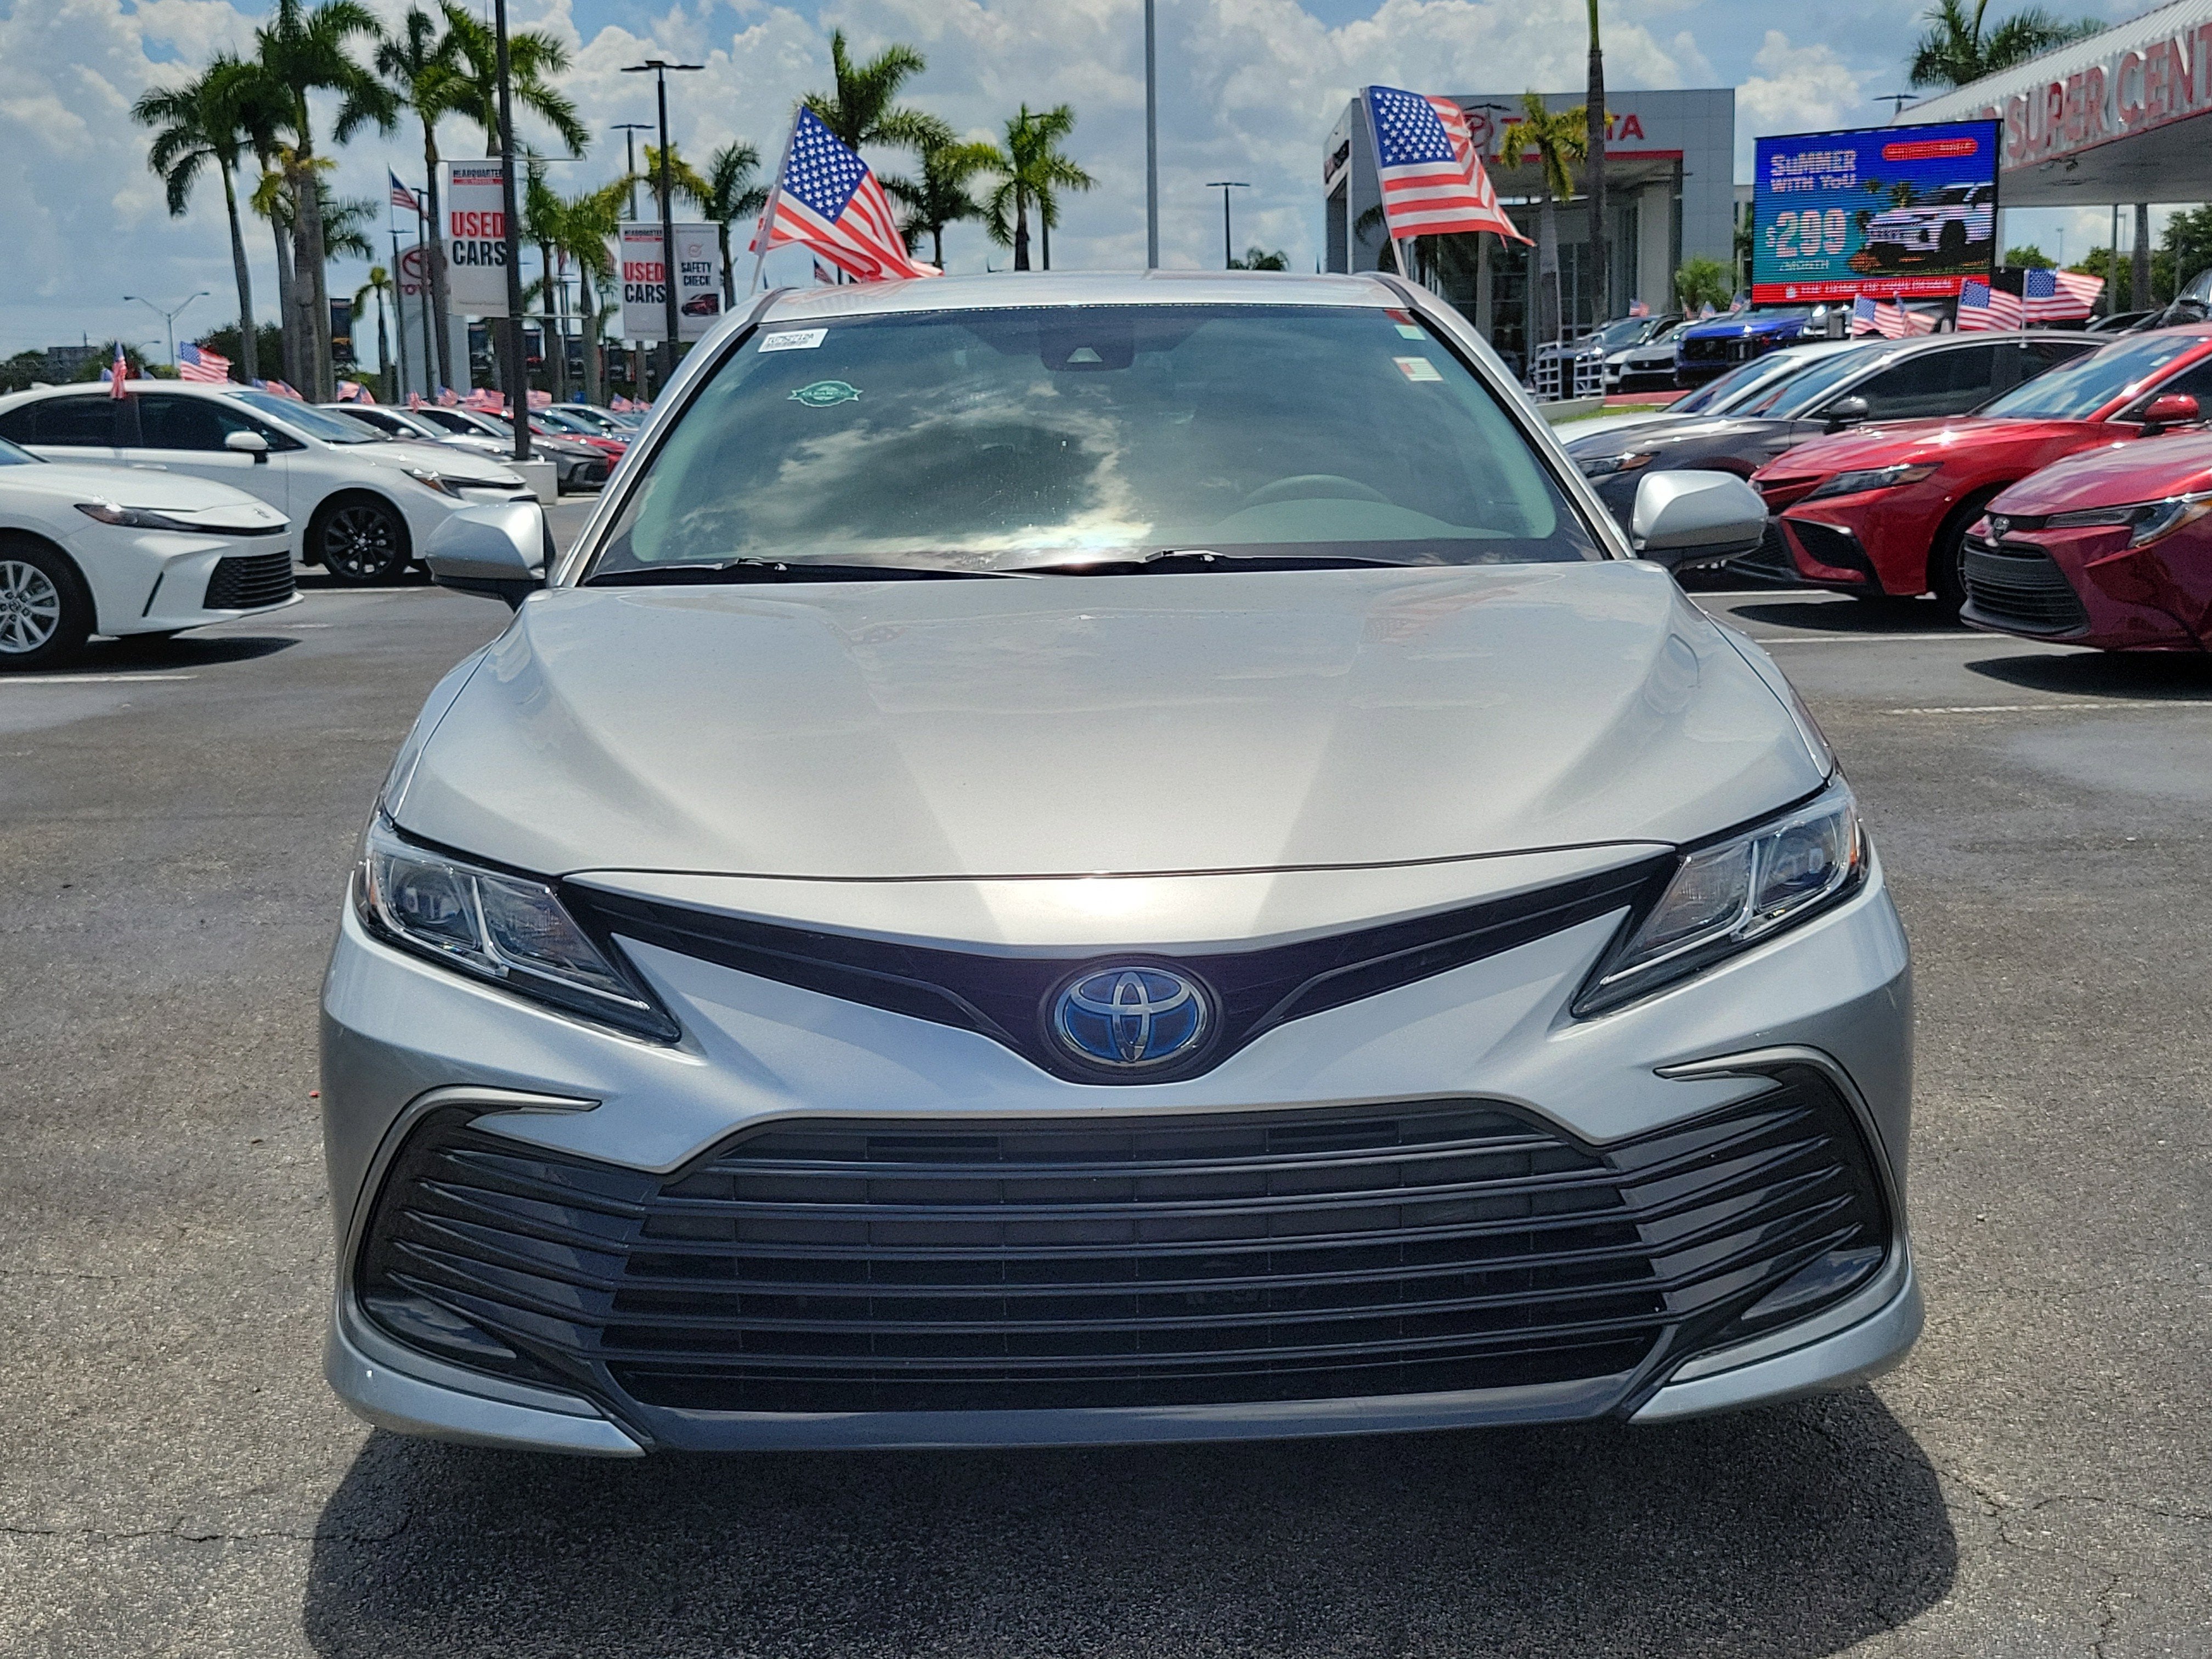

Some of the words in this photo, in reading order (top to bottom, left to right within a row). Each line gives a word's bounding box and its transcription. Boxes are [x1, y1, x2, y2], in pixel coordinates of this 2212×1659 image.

[2007, 66, 2104, 159] SUPER
[1770, 176, 1814, 192] WITH
[452, 212, 505, 238] USED
[453, 240, 507, 266] CARS
[624, 262, 665, 282] USED
[681, 262, 712, 273] SAFETY
[684, 275, 712, 286] CHECK
[625, 284, 666, 303] CARS
